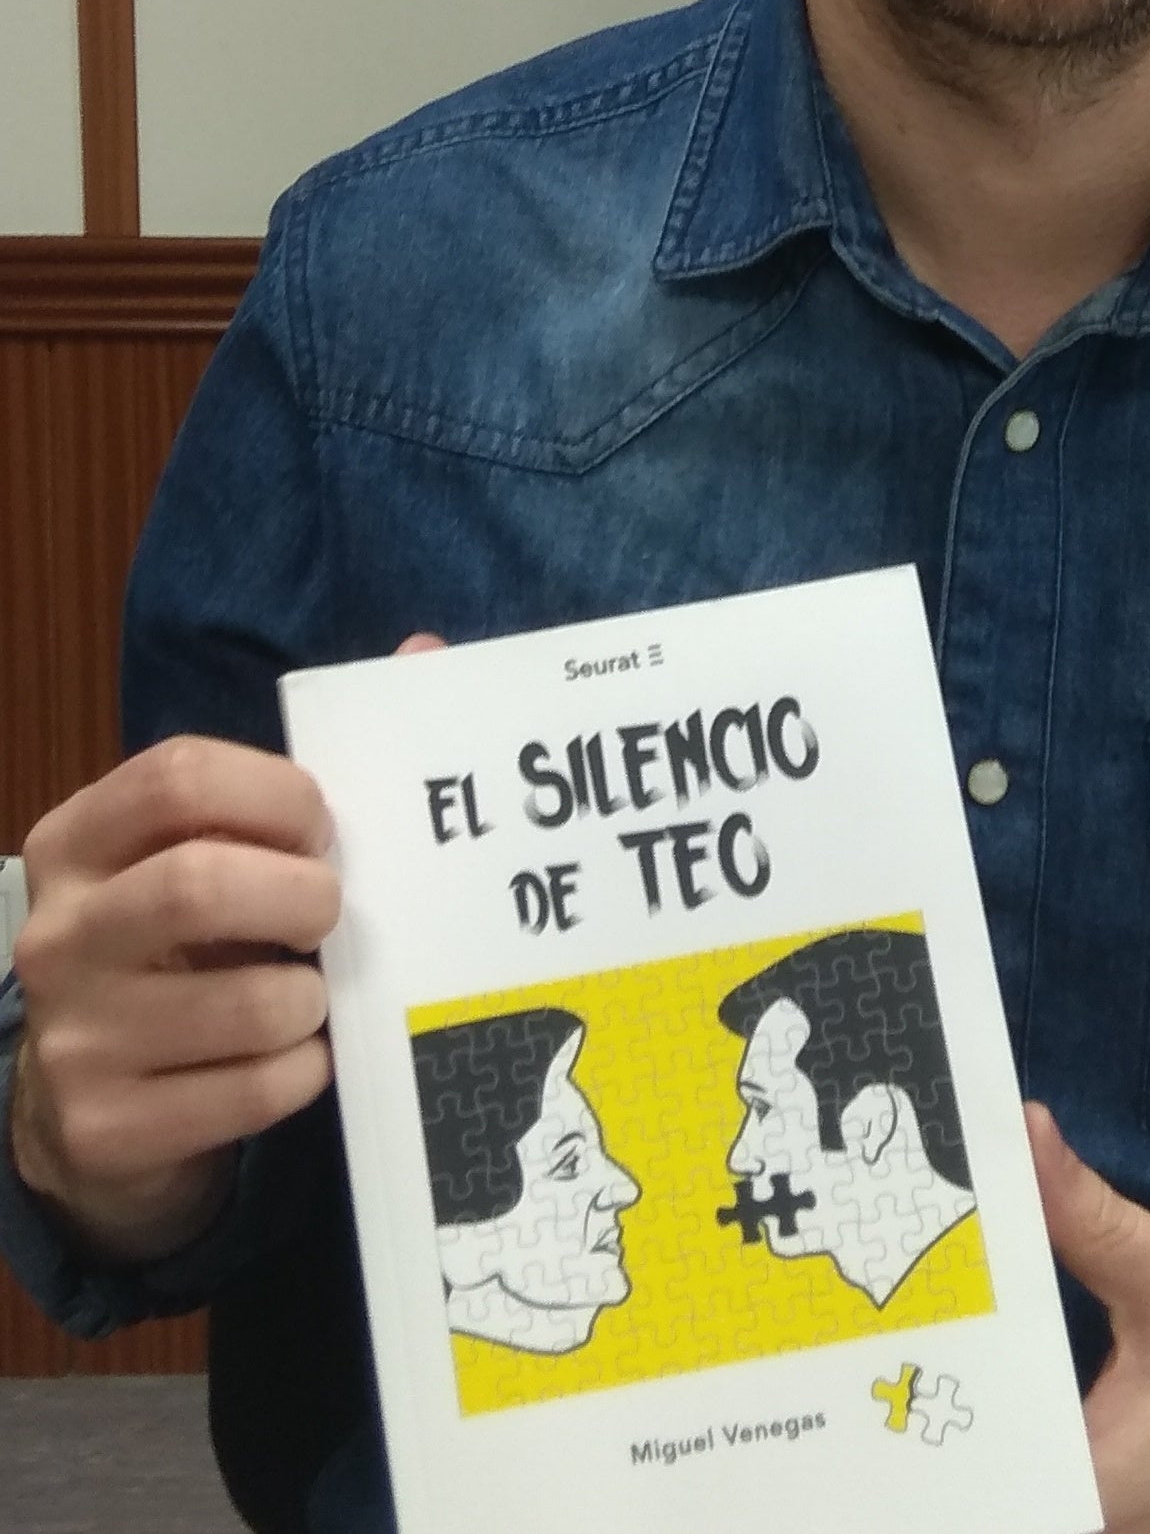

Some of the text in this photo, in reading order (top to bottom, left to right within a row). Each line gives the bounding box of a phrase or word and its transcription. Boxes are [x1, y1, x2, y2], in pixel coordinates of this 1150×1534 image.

[564, 650, 641, 682] Seurat
[424, 695, 820, 845] EL SILENCIO
[508, 811, 771, 937] DE TEO
[630, 1412, 826, 1467] Miguel Venegas
